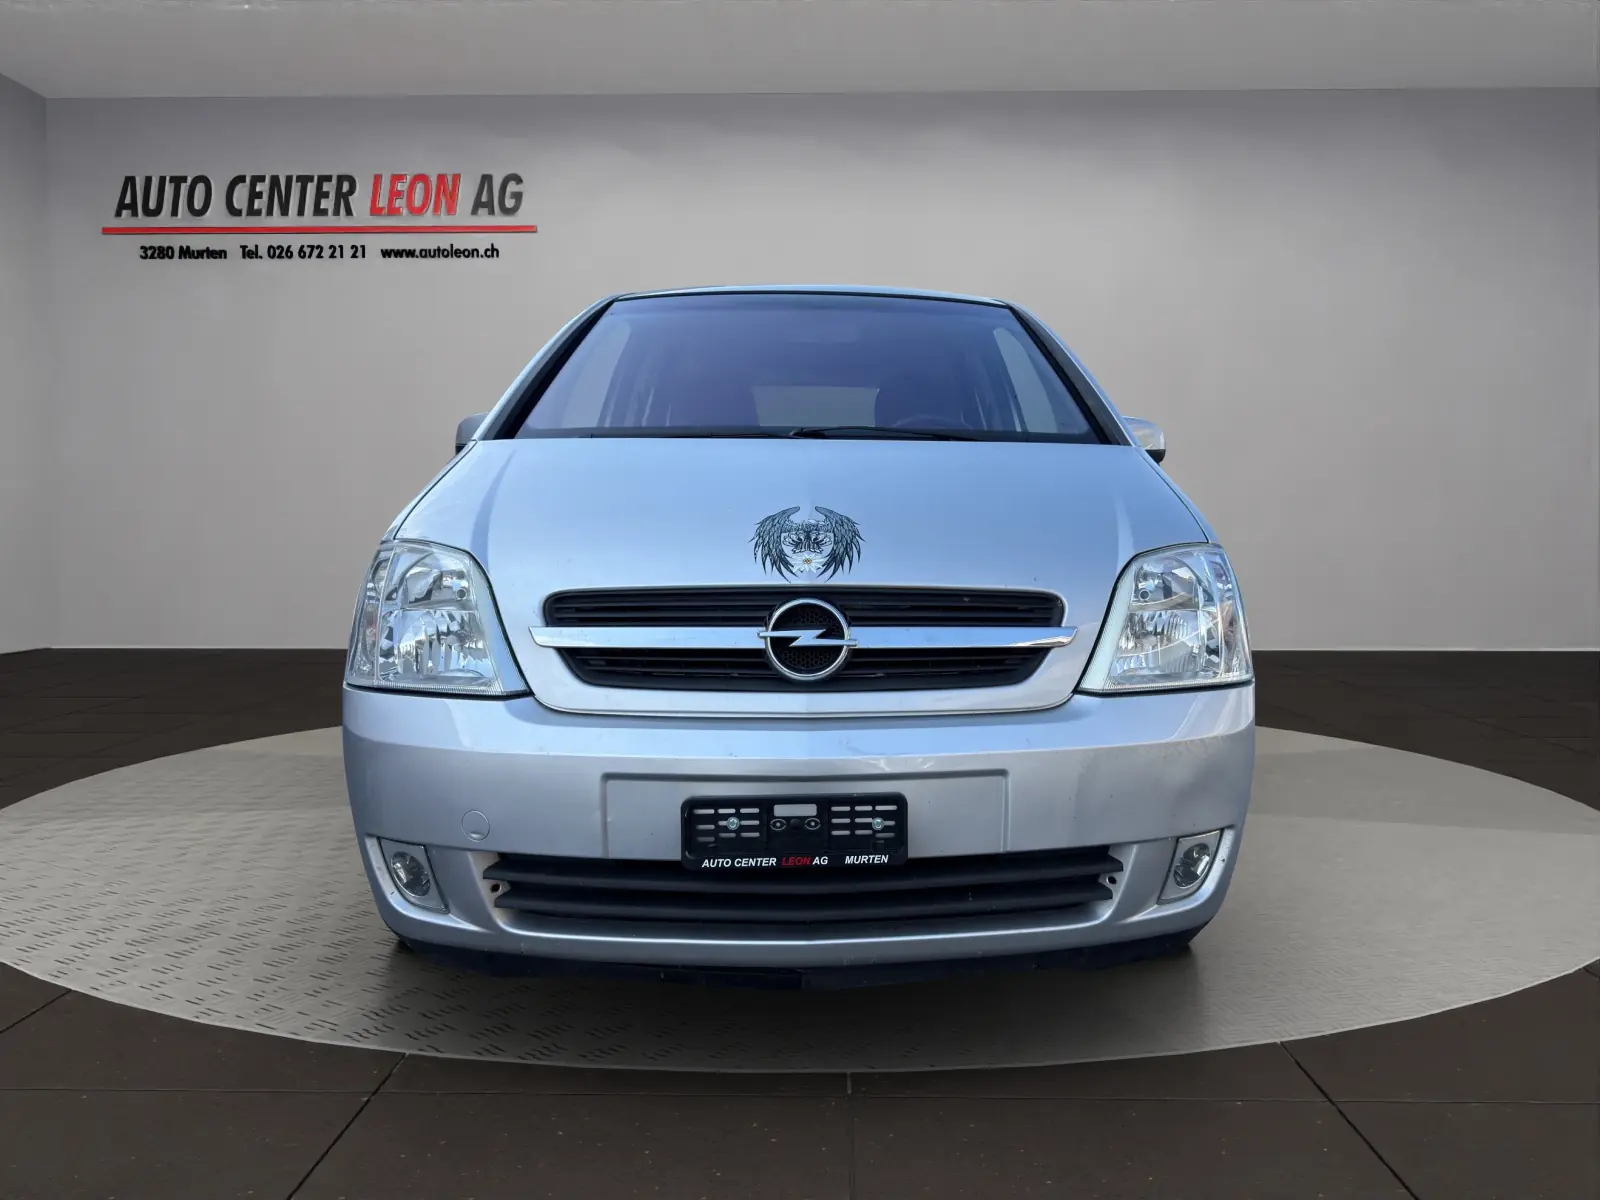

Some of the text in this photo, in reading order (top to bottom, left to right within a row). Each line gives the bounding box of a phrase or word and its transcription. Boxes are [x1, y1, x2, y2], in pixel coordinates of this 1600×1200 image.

[114, 174, 524, 217] AUTO CENTER LEON AG
[140, 244, 500, 260] 3280 Murten Tel. 026 672 21 21 www.autoleon.ch
[702, 855, 889, 868] AUTO CENTER LEON AG MURTEN
